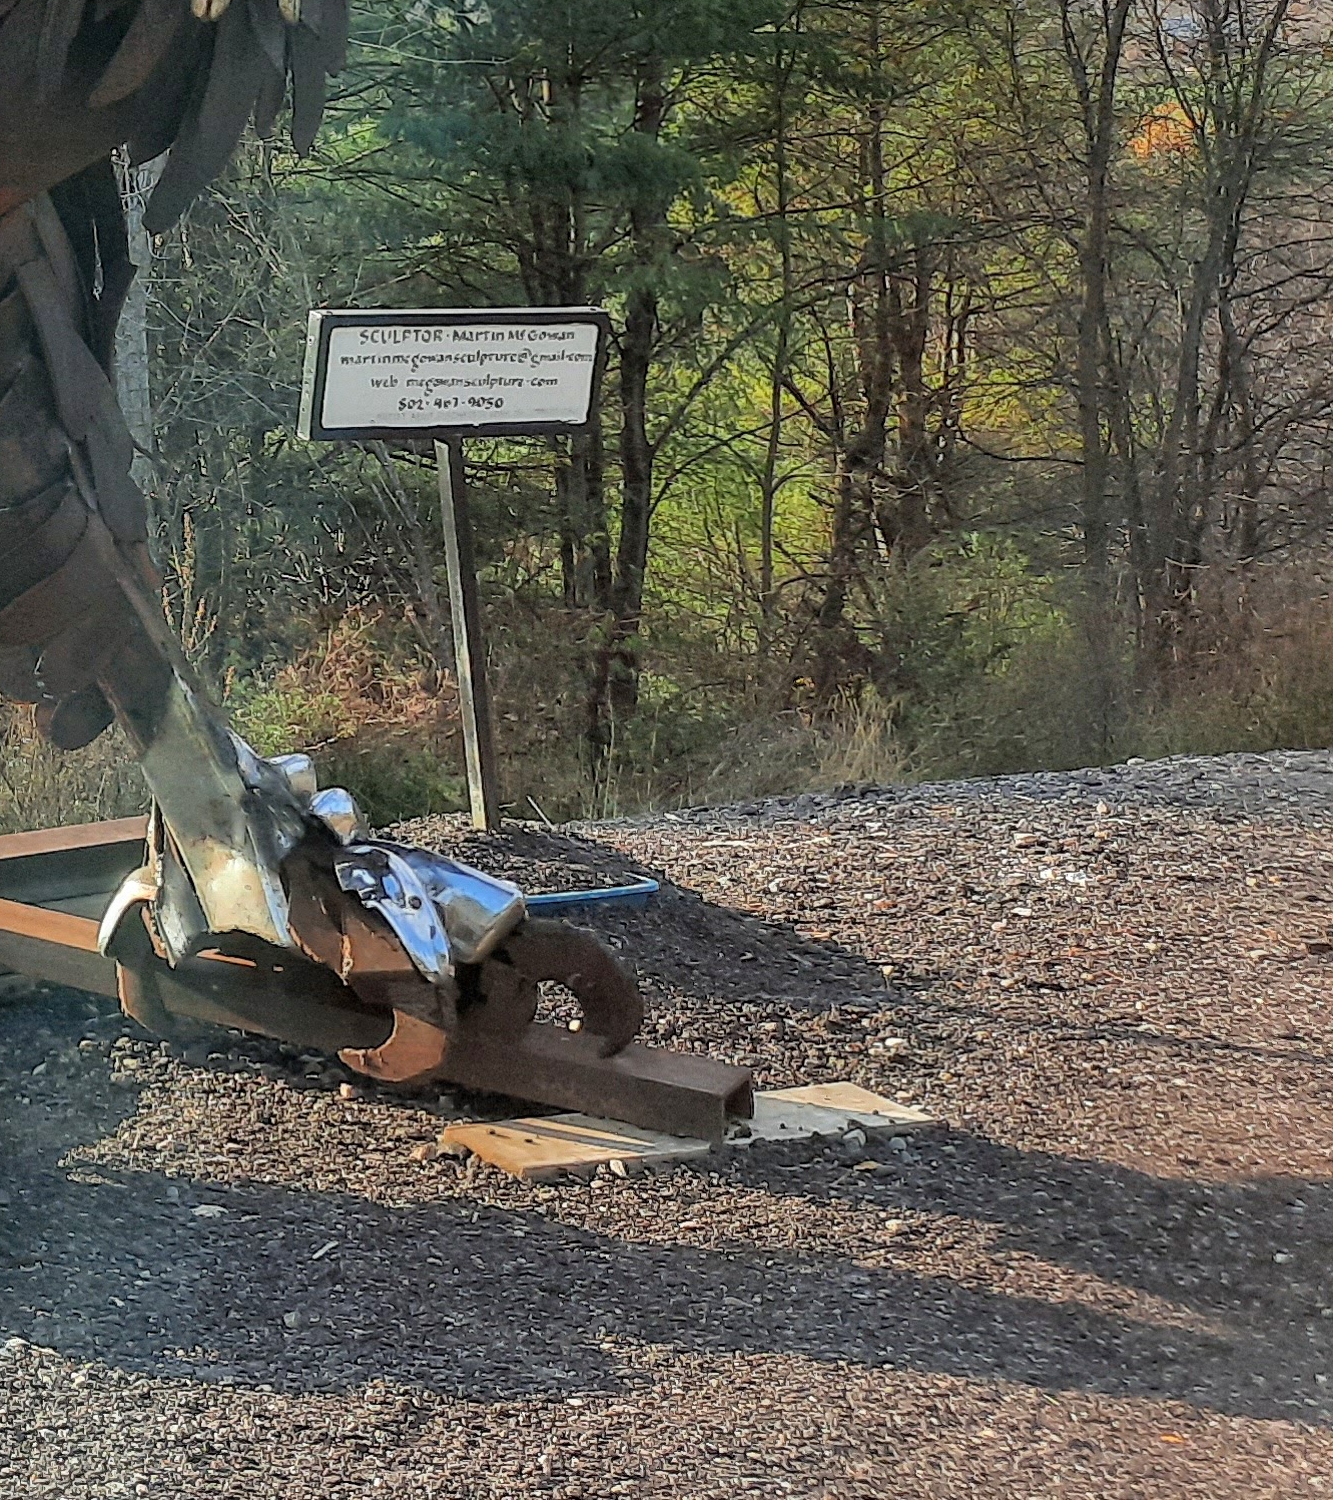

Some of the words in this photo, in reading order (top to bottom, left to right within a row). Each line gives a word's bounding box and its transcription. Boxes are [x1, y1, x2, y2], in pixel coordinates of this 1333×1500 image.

[359, 329, 443, 345] SCULPTOR
[452, 329, 504, 342] Martin
[370, 375, 399, 388] web
